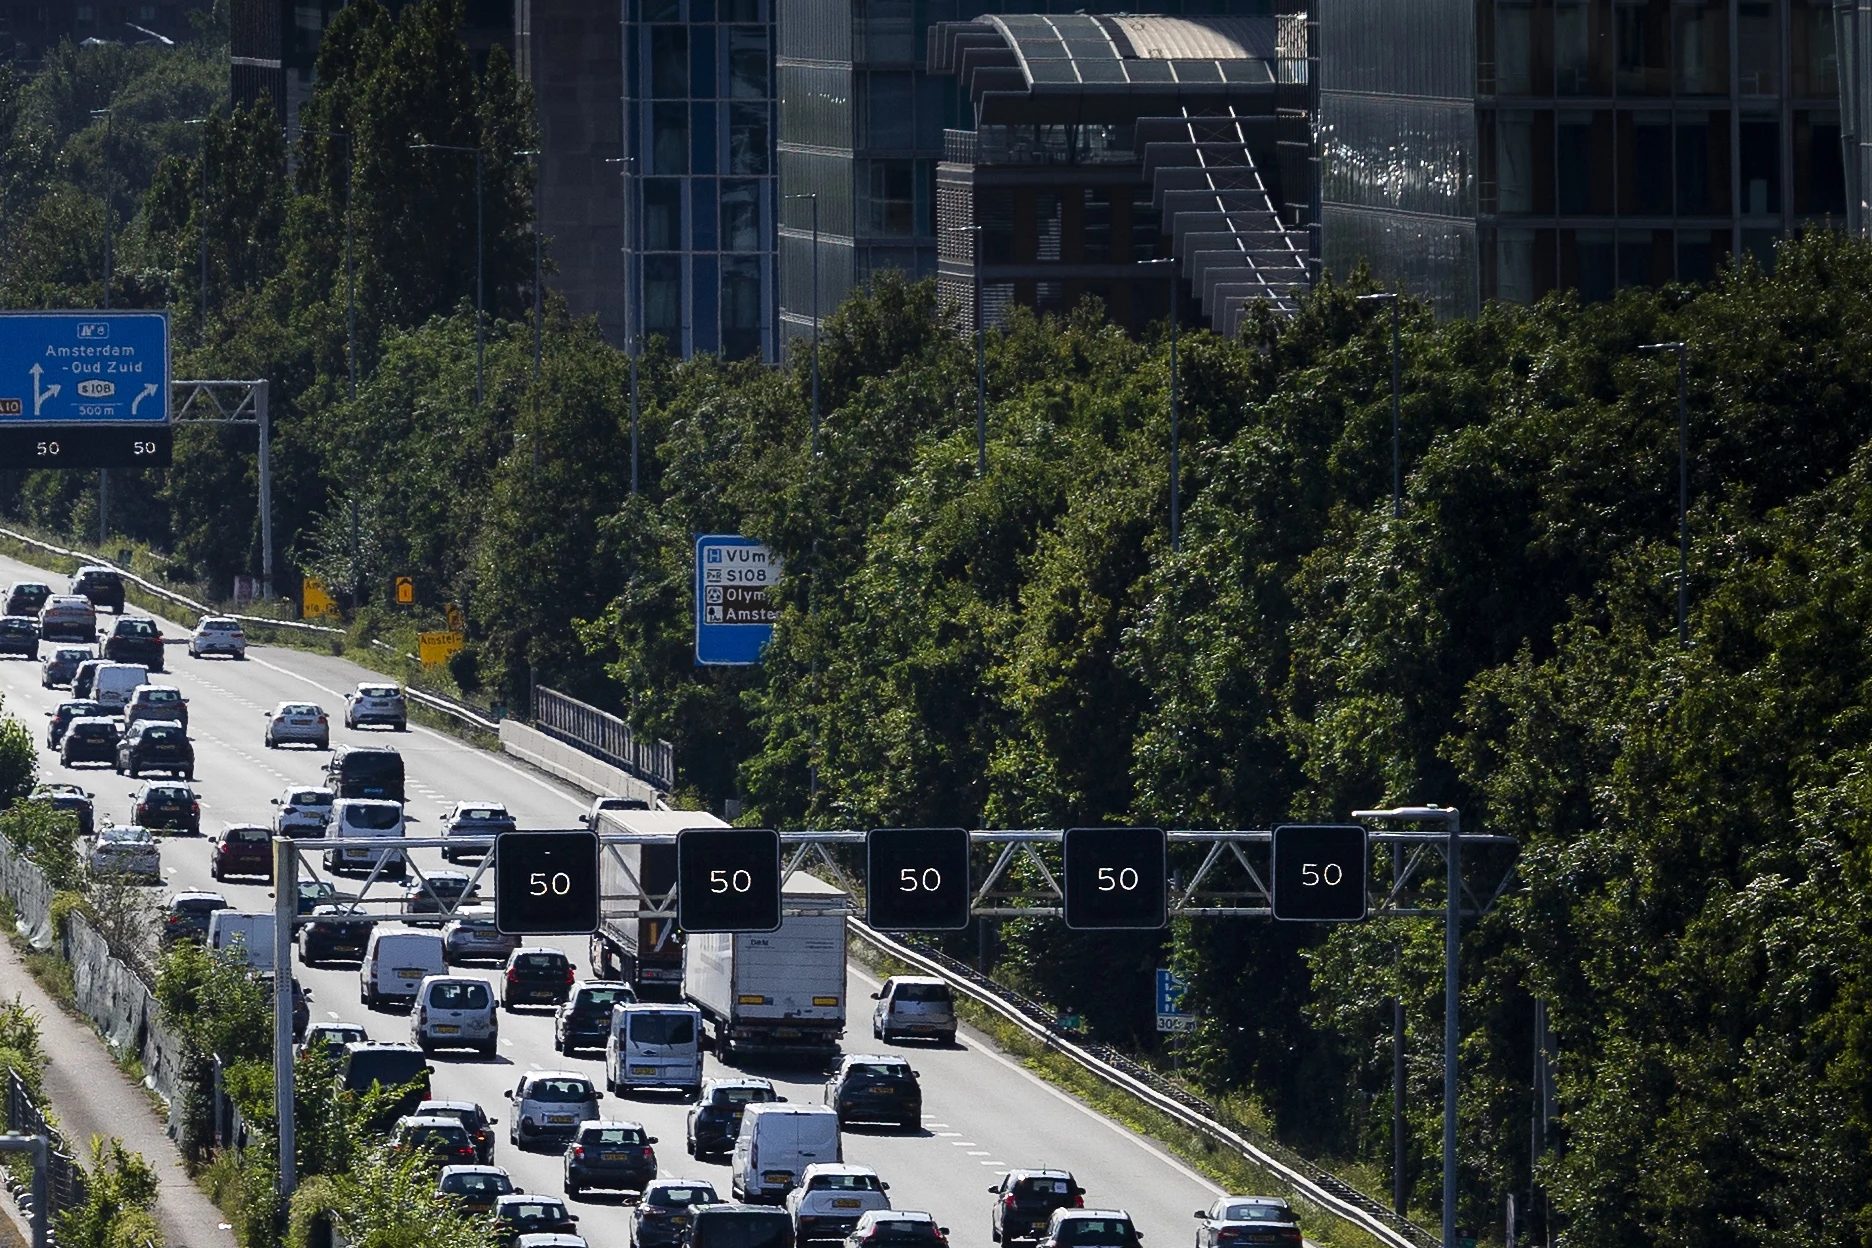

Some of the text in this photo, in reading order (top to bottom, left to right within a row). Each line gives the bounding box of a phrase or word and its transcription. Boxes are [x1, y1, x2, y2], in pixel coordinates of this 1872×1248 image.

[97, 327, 105, 335] 8
[46, 345, 134, 356] Amsterdam
[107, 362, 142, 373] Zuid
[79, 407, 114, 415] 500 m
[36, 442, 59, 455] 50
[133, 442, 155, 455] 50
[727, 550, 771, 562] VUm
[727, 569, 766, 582] S108
[421, 635, 462, 644] Amstel-
[711, 869, 751, 893] 50
[900, 868, 941, 892] 50
[1097, 867, 1138, 891] 50
[1301, 863, 1342, 887] 50
[530, 873, 570, 895] 50
